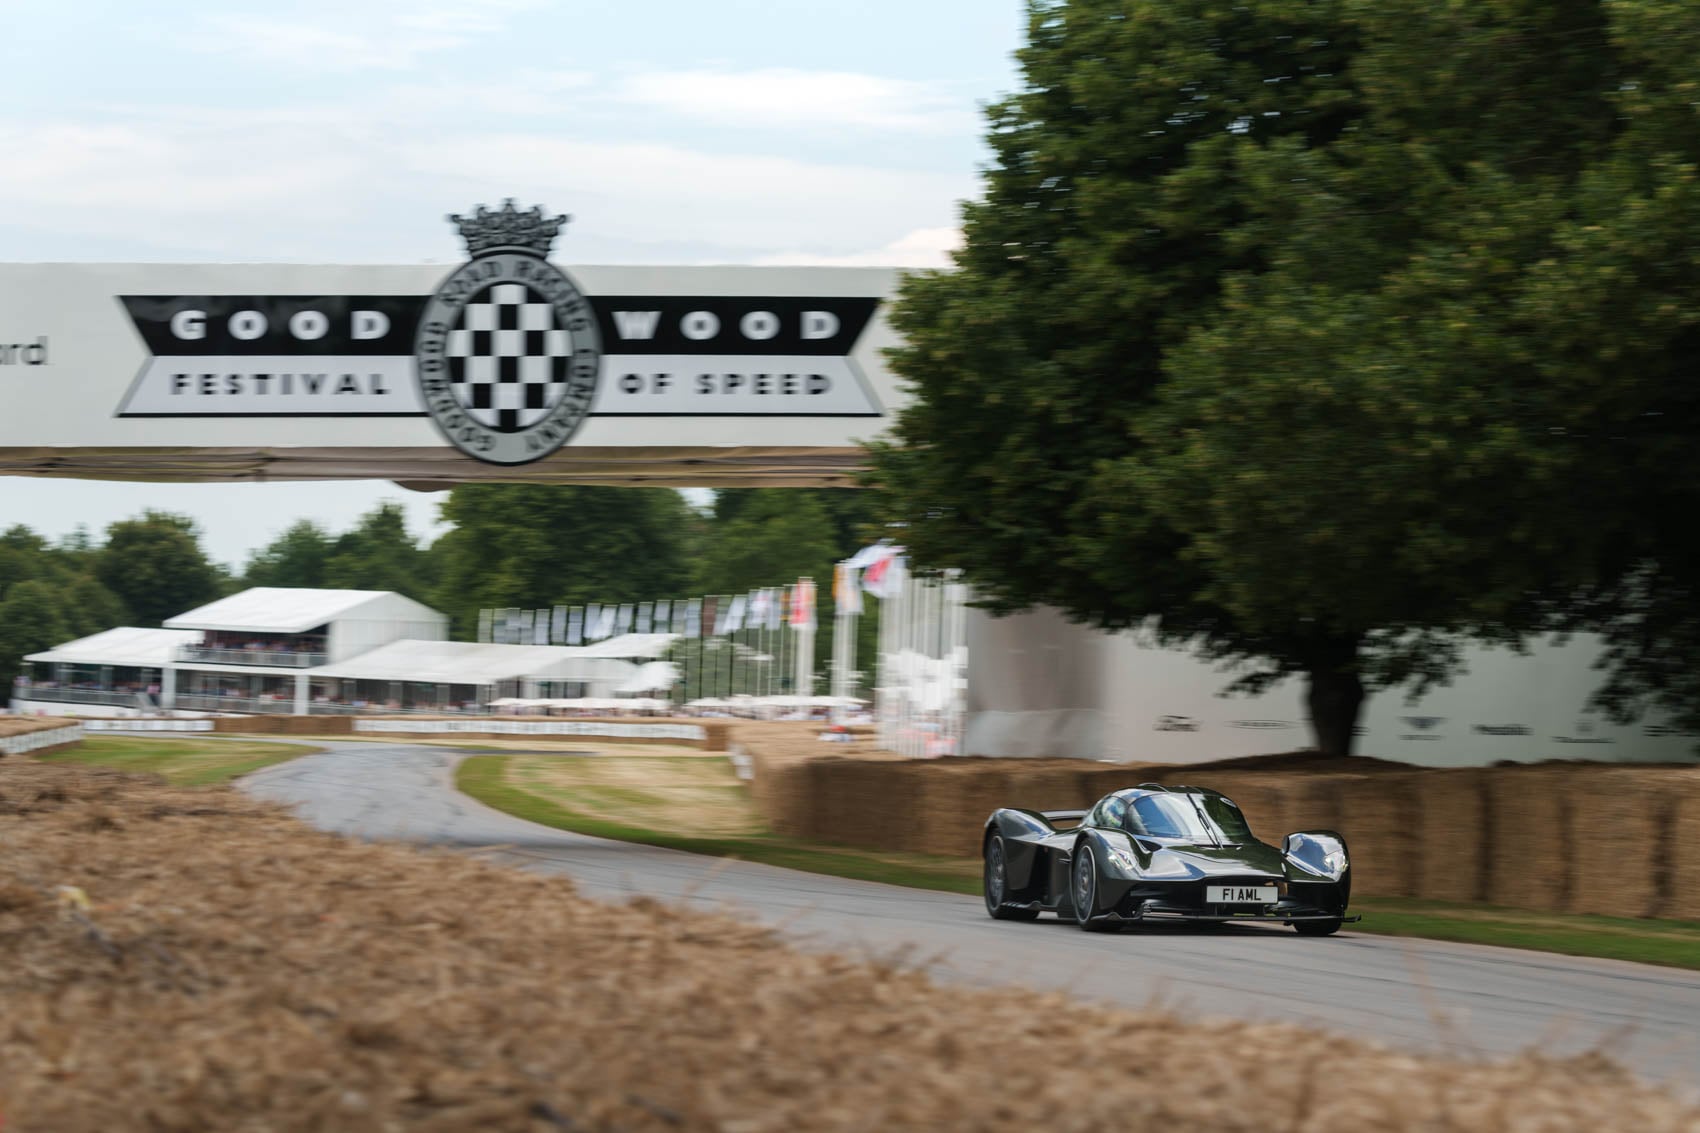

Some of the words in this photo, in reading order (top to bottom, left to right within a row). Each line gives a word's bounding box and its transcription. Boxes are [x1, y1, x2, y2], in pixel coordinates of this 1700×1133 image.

[170, 309, 390, 341] GOOD
[611, 310, 840, 341] WOOD
[171, 373, 389, 396] FESTIVAL
[618, 372, 671, 395] OF
[696, 373, 831, 396] SPEED
[1222, 887, 1234, 901] F1
[1237, 887, 1262, 901] AML
